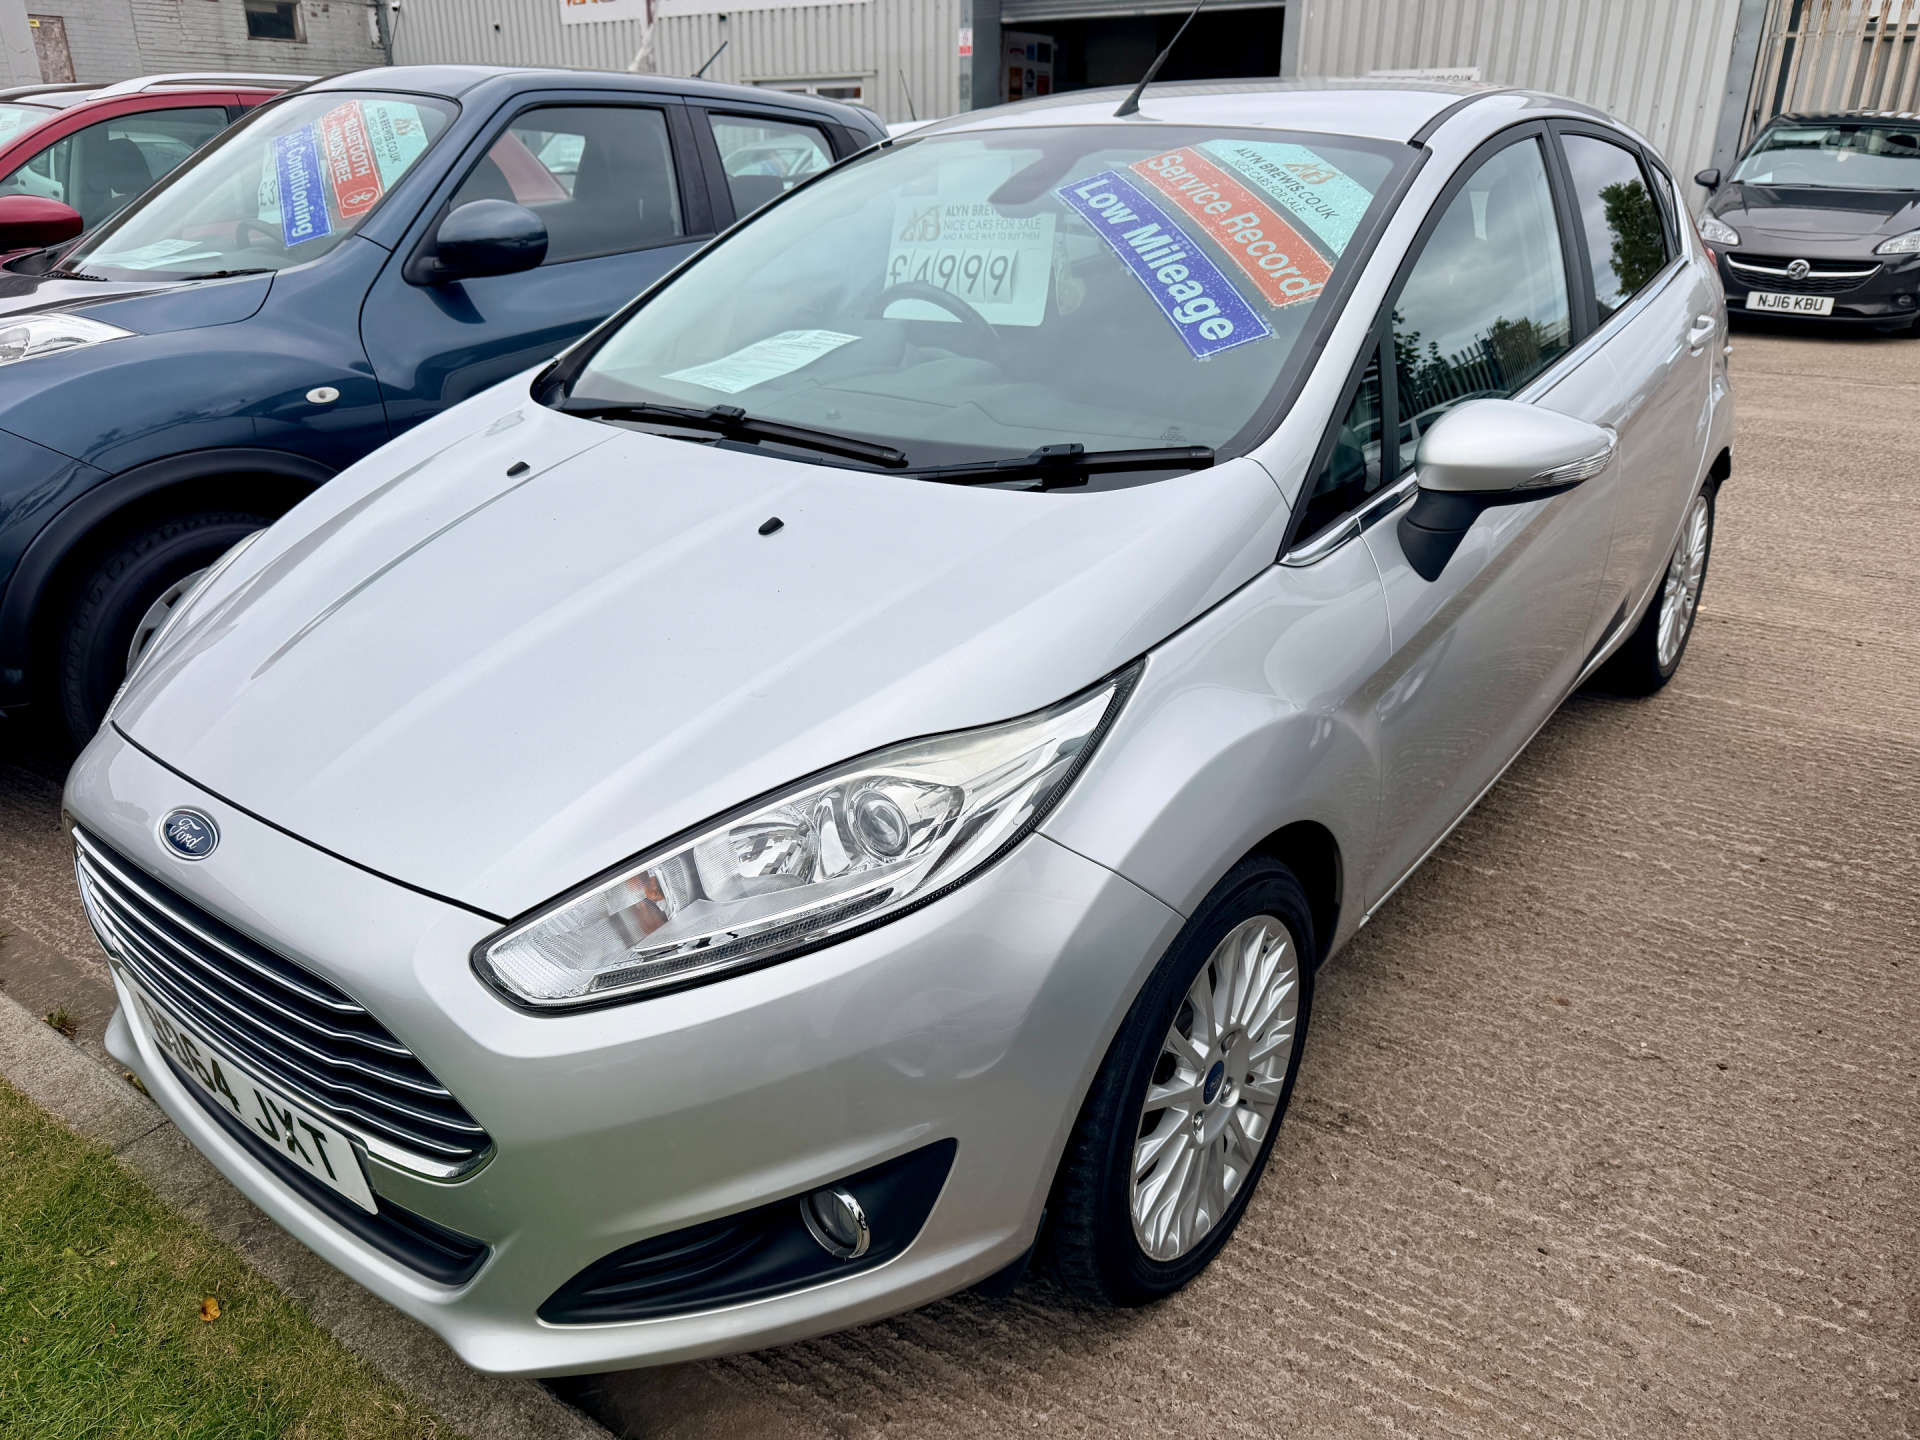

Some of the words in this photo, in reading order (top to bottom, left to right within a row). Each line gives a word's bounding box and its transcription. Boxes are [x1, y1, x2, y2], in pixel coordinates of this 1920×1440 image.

[286, 145, 315, 238] Conditioning
[1232, 147, 1266, 165] ALYN
[1259, 162, 1340, 220] BREWIS.CO.UK
[1270, 185, 1289, 198] FOR
[1282, 196, 1307, 214] SALE
[943, 218, 966, 231] NICE
[967, 218, 994, 231] CARS
[995, 218, 1016, 231] FOR
[1016, 217, 1041, 231] SALE
[945, 204, 969, 217] ALYN
[1147, 154, 1233, 215] Service
[1219, 211, 1325, 297] Record
[1073, 178, 1140, 225] Low
[1121, 222, 1235, 341] Mileage
[1757, 294, 1791, 309] NJ16
[1793, 296, 1825, 311] KBU
[169, 818, 205, 850] Ford
[252, 1087, 338, 1182] JXT
